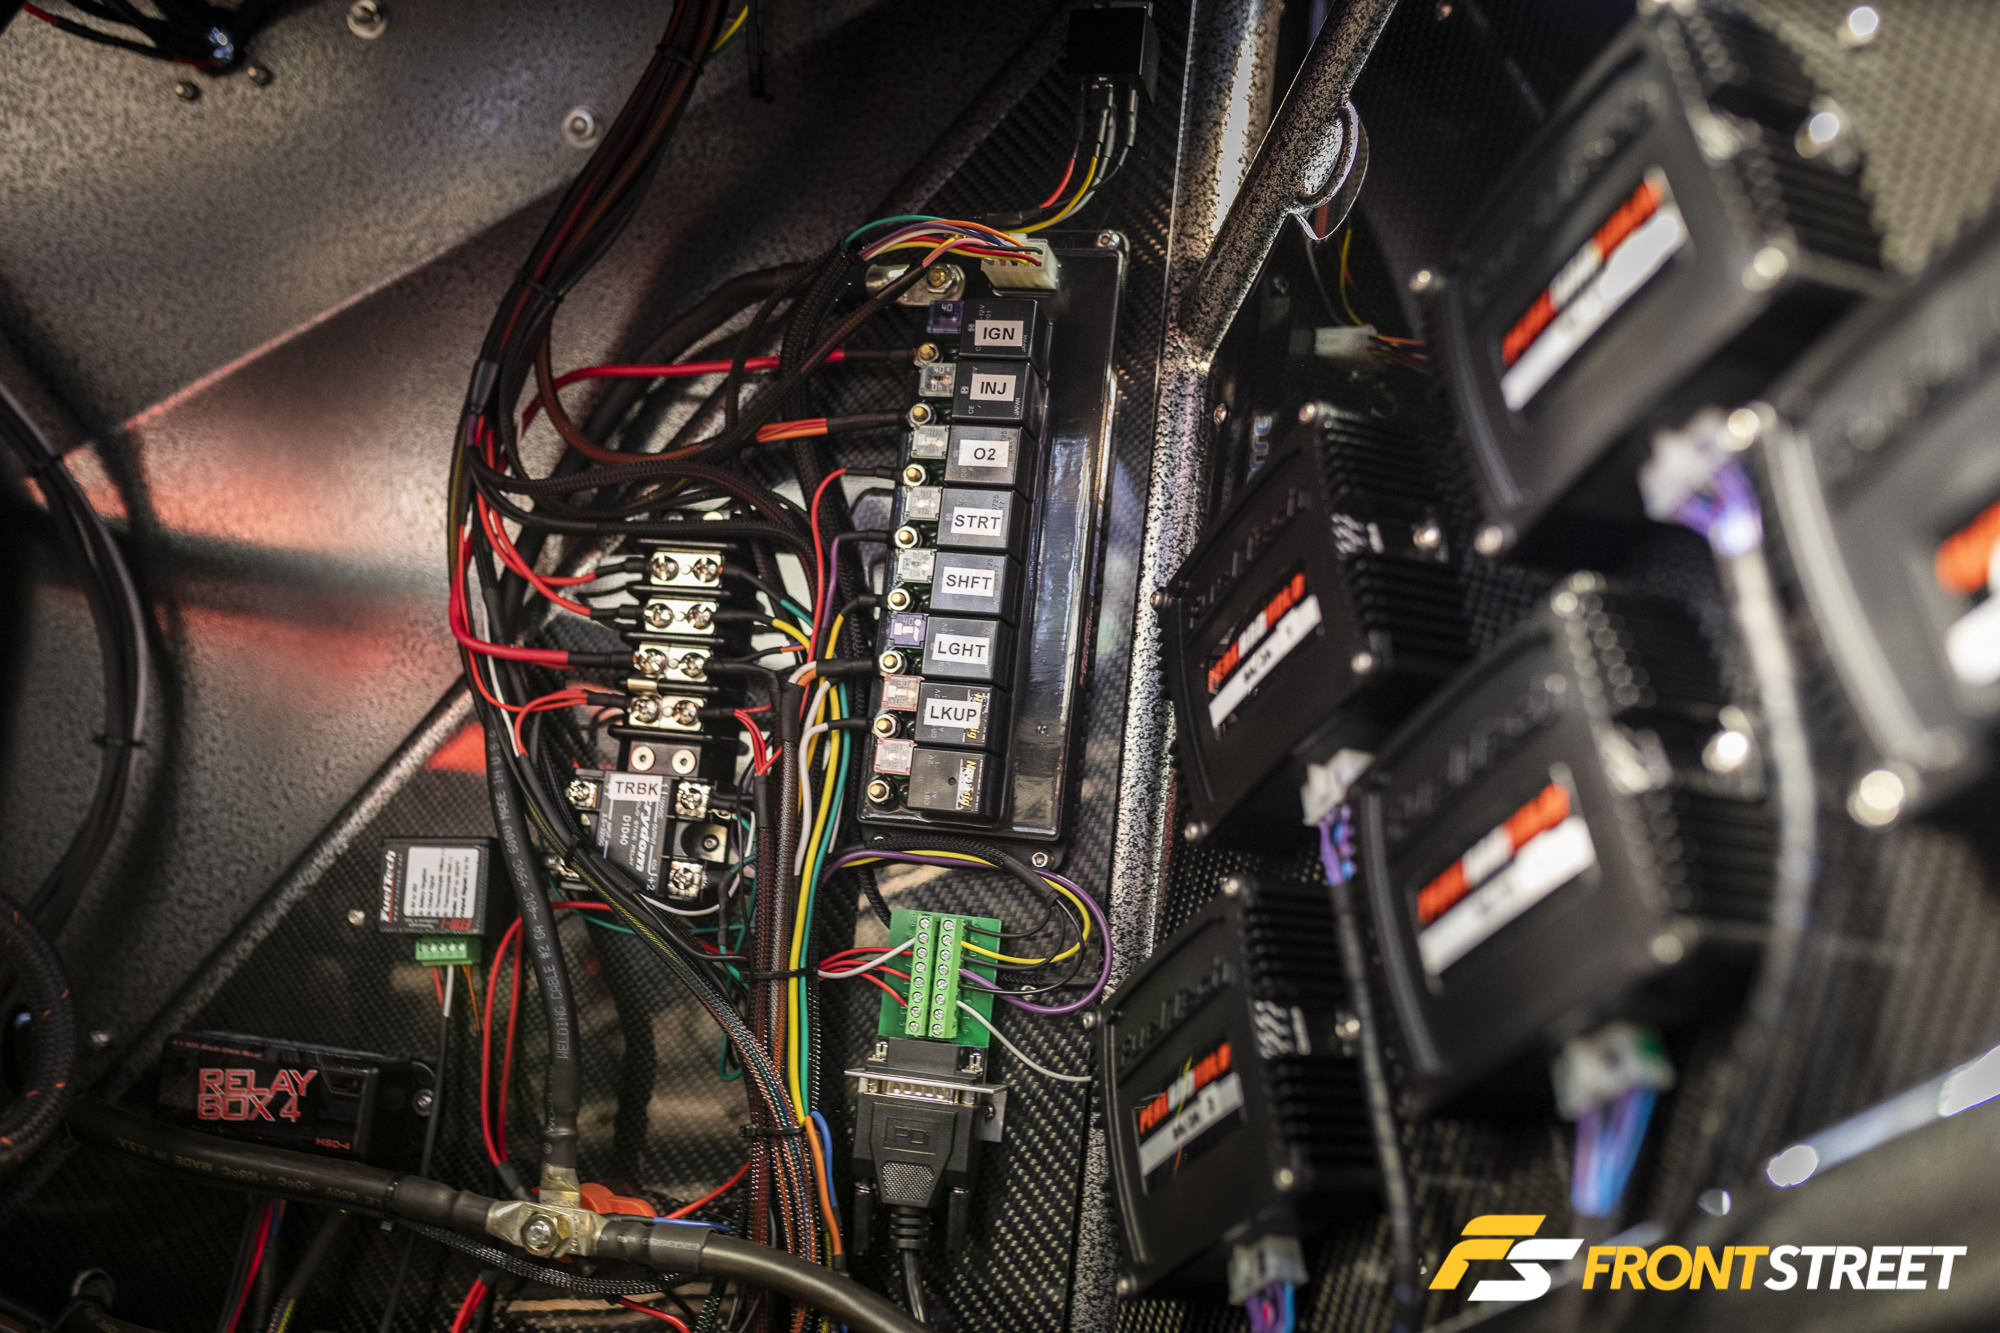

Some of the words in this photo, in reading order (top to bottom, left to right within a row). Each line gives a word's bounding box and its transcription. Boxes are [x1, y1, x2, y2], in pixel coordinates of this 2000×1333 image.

[941, 304, 952, 312] 40
[983, 327, 1015, 340] IGN
[980, 381, 1007, 395] INJ
[973, 447, 997, 461] O2
[954, 514, 1001, 530] STRT
[946, 574, 992, 590] SHFT
[937, 641, 985, 658] LGHT
[930, 706, 977, 722] LKUP
[492, 769, 505, 785] IN
[615, 781, 658, 796] TRBK
[495, 790, 511, 820] MADE
[621, 815, 633, 846] D1D40
[502, 825, 520, 855] 600V
[380, 850, 397, 922] FuelTech
[533, 924, 546, 941] GA
[537, 944, 552, 960] #2
[543, 963, 563, 1000] CABLE
[556, 1005, 569, 1060] WELDING
[199, 1067, 318, 1096] RELAY
[197, 1093, 276, 1121] BOX
[279, 1095, 301, 1123] 4
